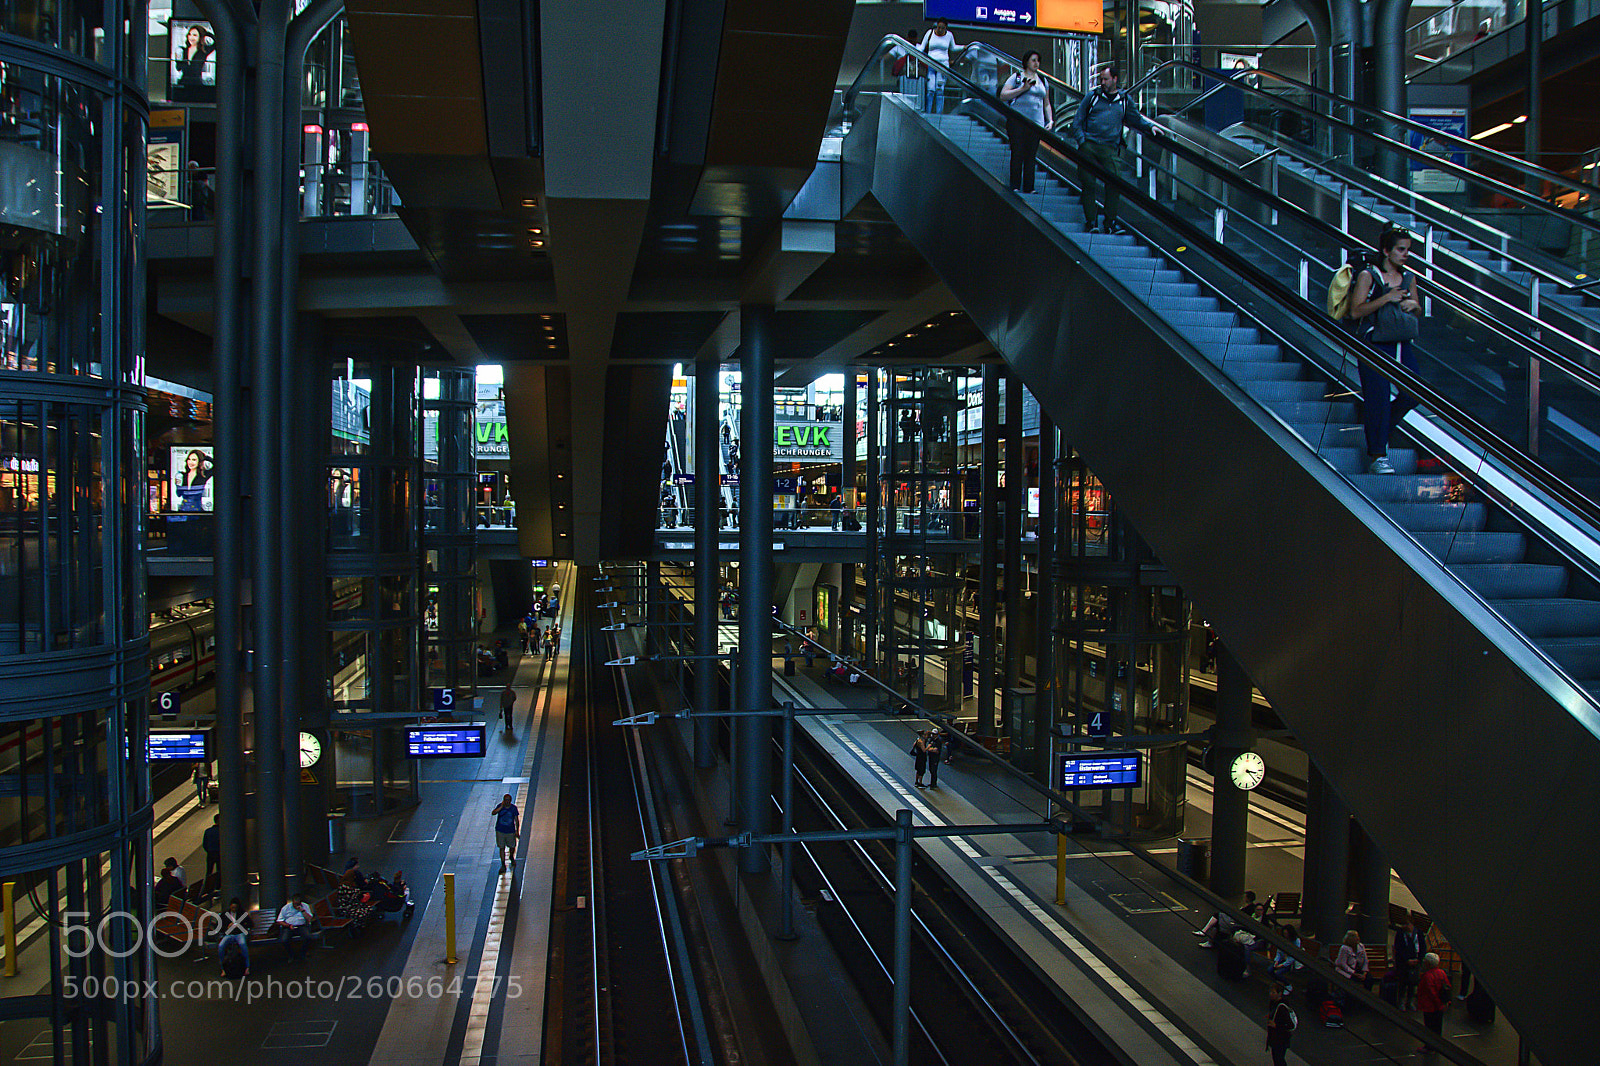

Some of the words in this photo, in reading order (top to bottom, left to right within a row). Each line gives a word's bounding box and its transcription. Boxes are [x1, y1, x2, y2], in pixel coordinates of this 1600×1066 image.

[994, 8, 1016, 17] Ausgang
[774, 425, 831, 447] EVK
[776, 478, 790, 488] 1-2
[160, 692, 173, 710] 6
[441, 688, 453, 706] 5
[1090, 712, 1103, 731] 4
